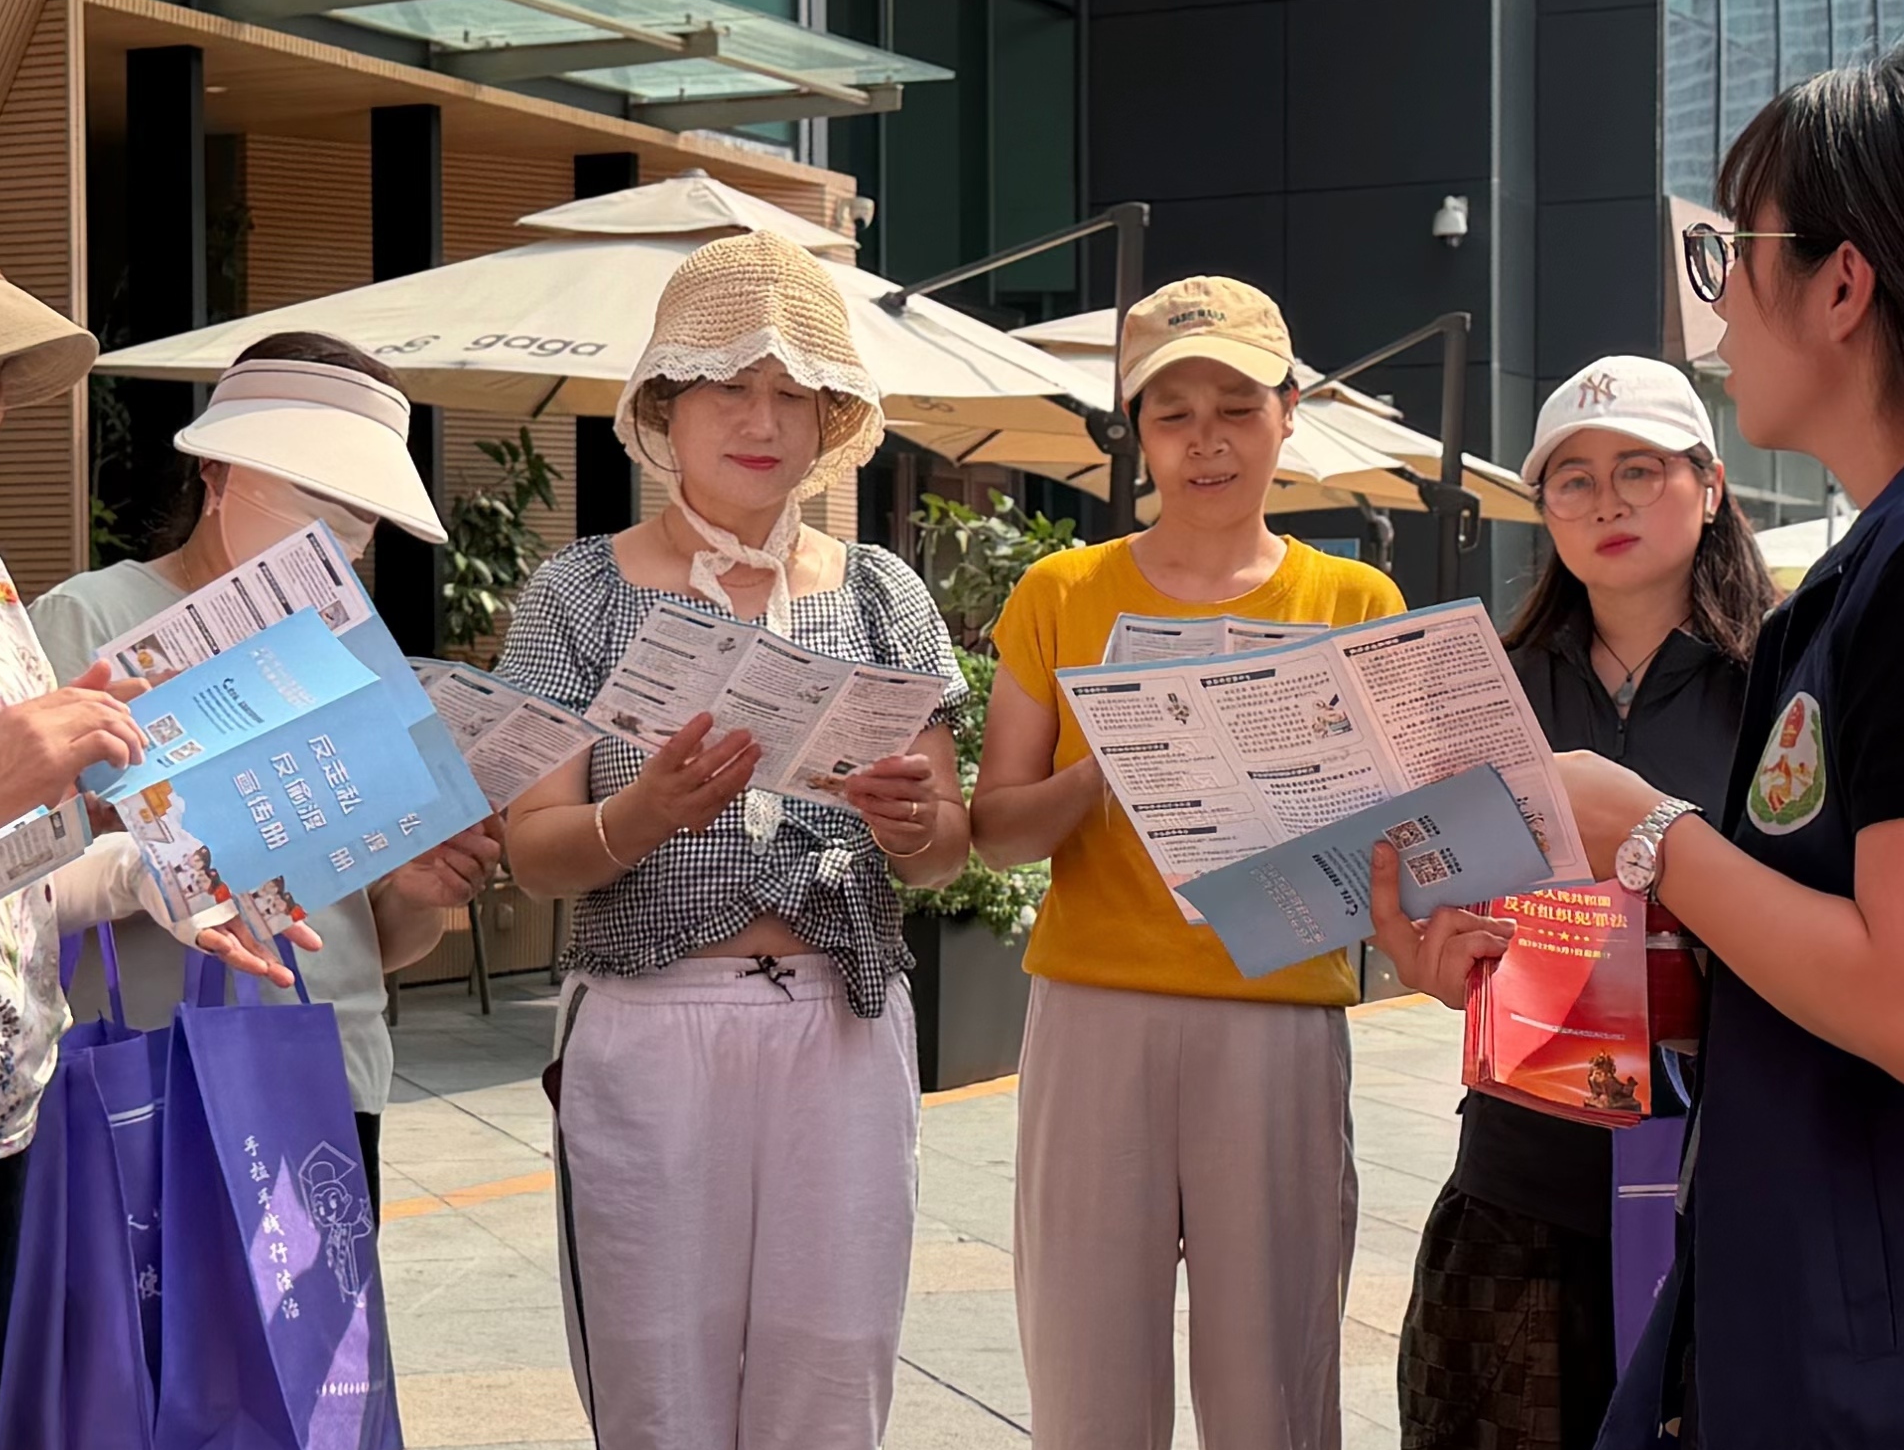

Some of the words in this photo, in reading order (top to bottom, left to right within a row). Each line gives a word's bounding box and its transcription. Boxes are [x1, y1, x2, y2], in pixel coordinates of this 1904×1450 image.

[463, 333, 607, 357] gaga
[232, 767, 291, 851] 宣传册
[270, 751, 329, 834] 反偷渡
[307, 734, 364, 817] 反走私
[1503, 895, 1628, 929] 反有组织犯罪法
[243, 1135, 301, 1319] 手拉手践行法治
